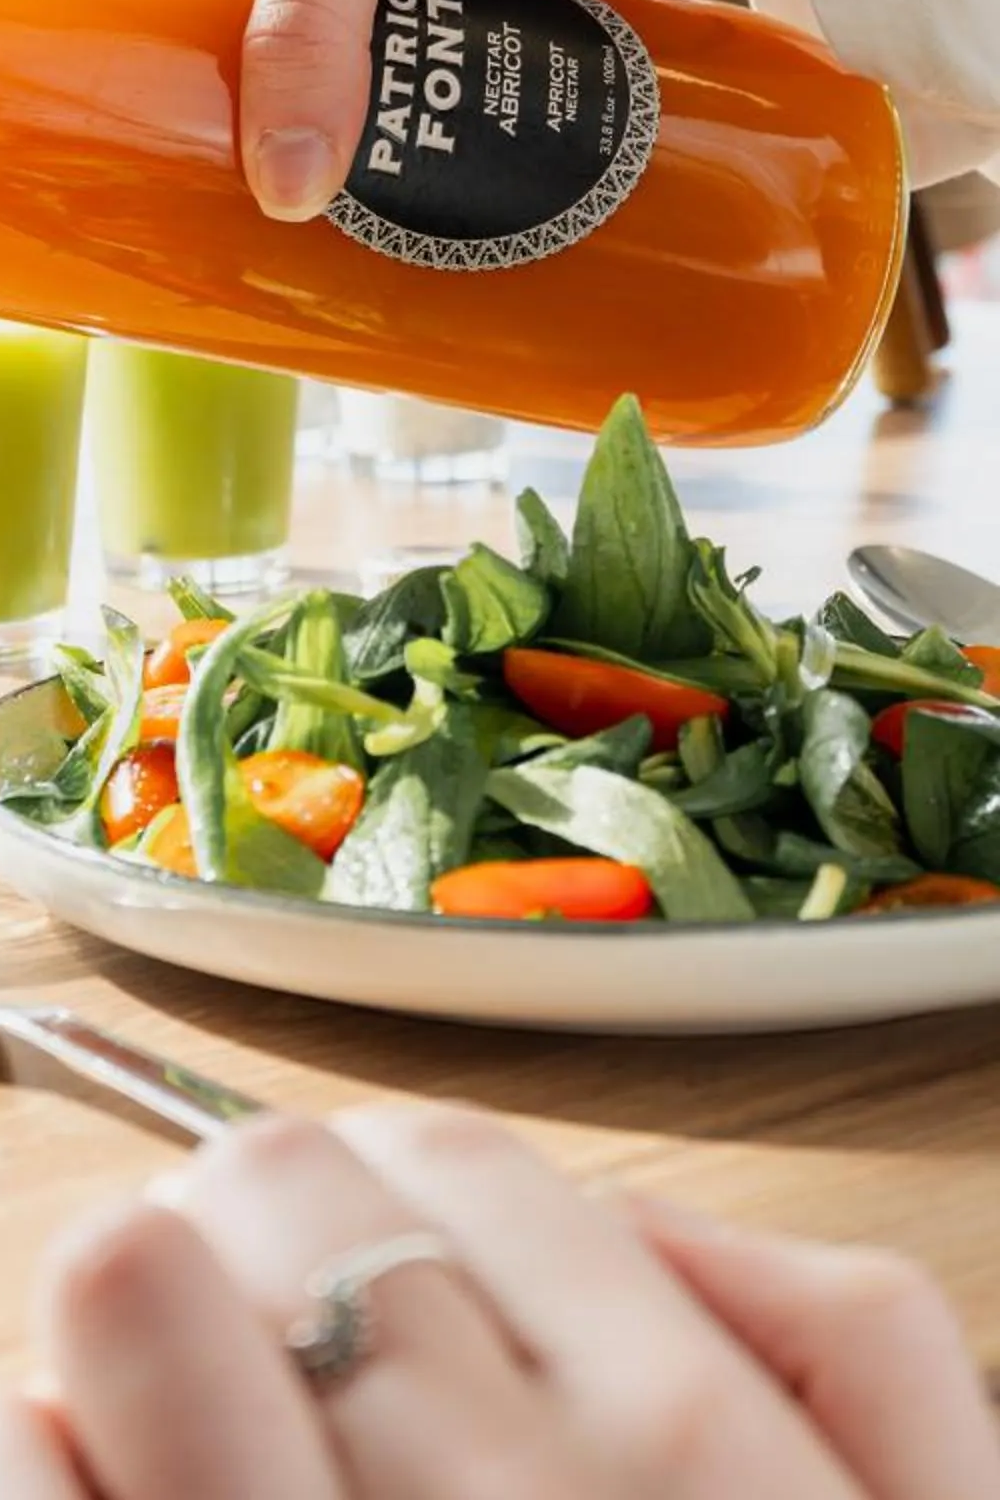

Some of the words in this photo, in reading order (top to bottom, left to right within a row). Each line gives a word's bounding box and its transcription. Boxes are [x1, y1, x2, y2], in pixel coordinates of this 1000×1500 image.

[483, 30, 503, 117] NECTAR
[499, 21, 522, 137] ABRICOT
[546, 40, 566, 132] APRICOT
[564, 57, 579, 122] NECTAR
[599, 127, 614, 156] 33.8
